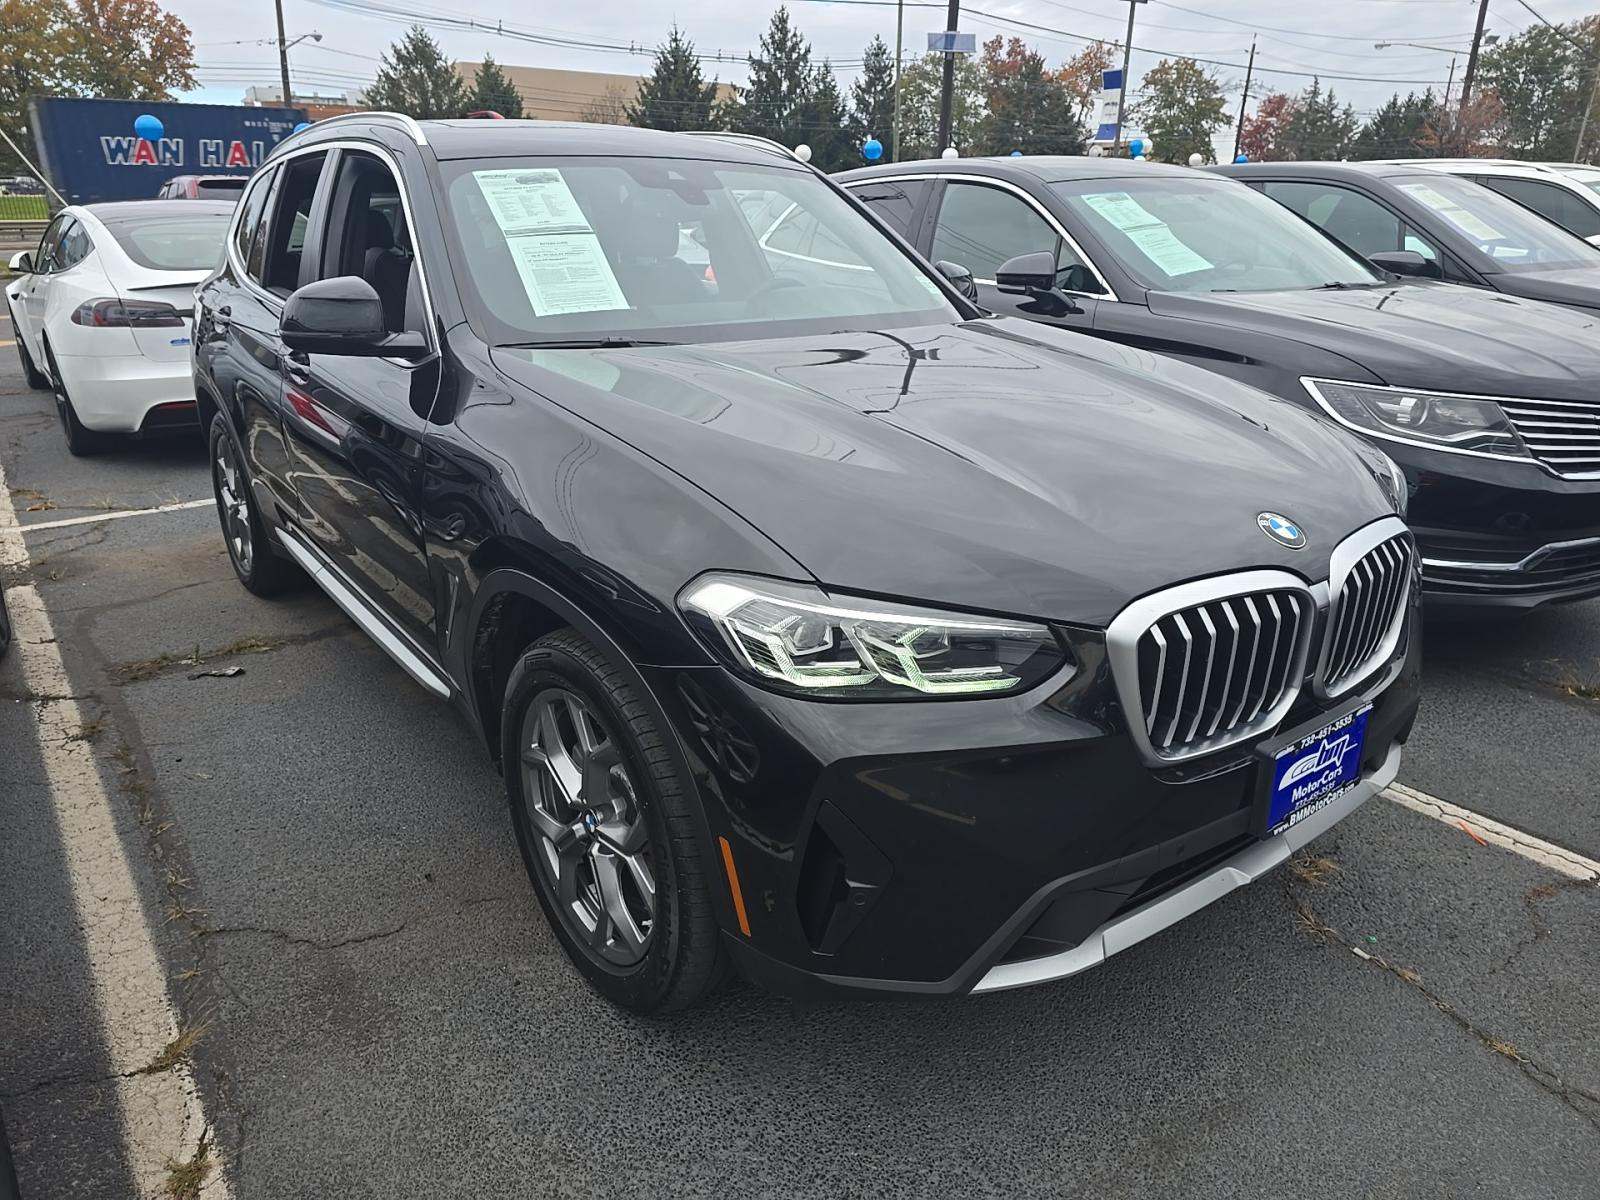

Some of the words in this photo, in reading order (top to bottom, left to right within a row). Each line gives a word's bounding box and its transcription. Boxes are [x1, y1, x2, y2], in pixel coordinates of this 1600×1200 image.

[101, 136, 184, 167] WAN
[199, 139, 264, 168] HAI
[1291, 766, 1343, 802] MotorCars
[1272, 782, 1355, 836] www.BMMotorCars.com
